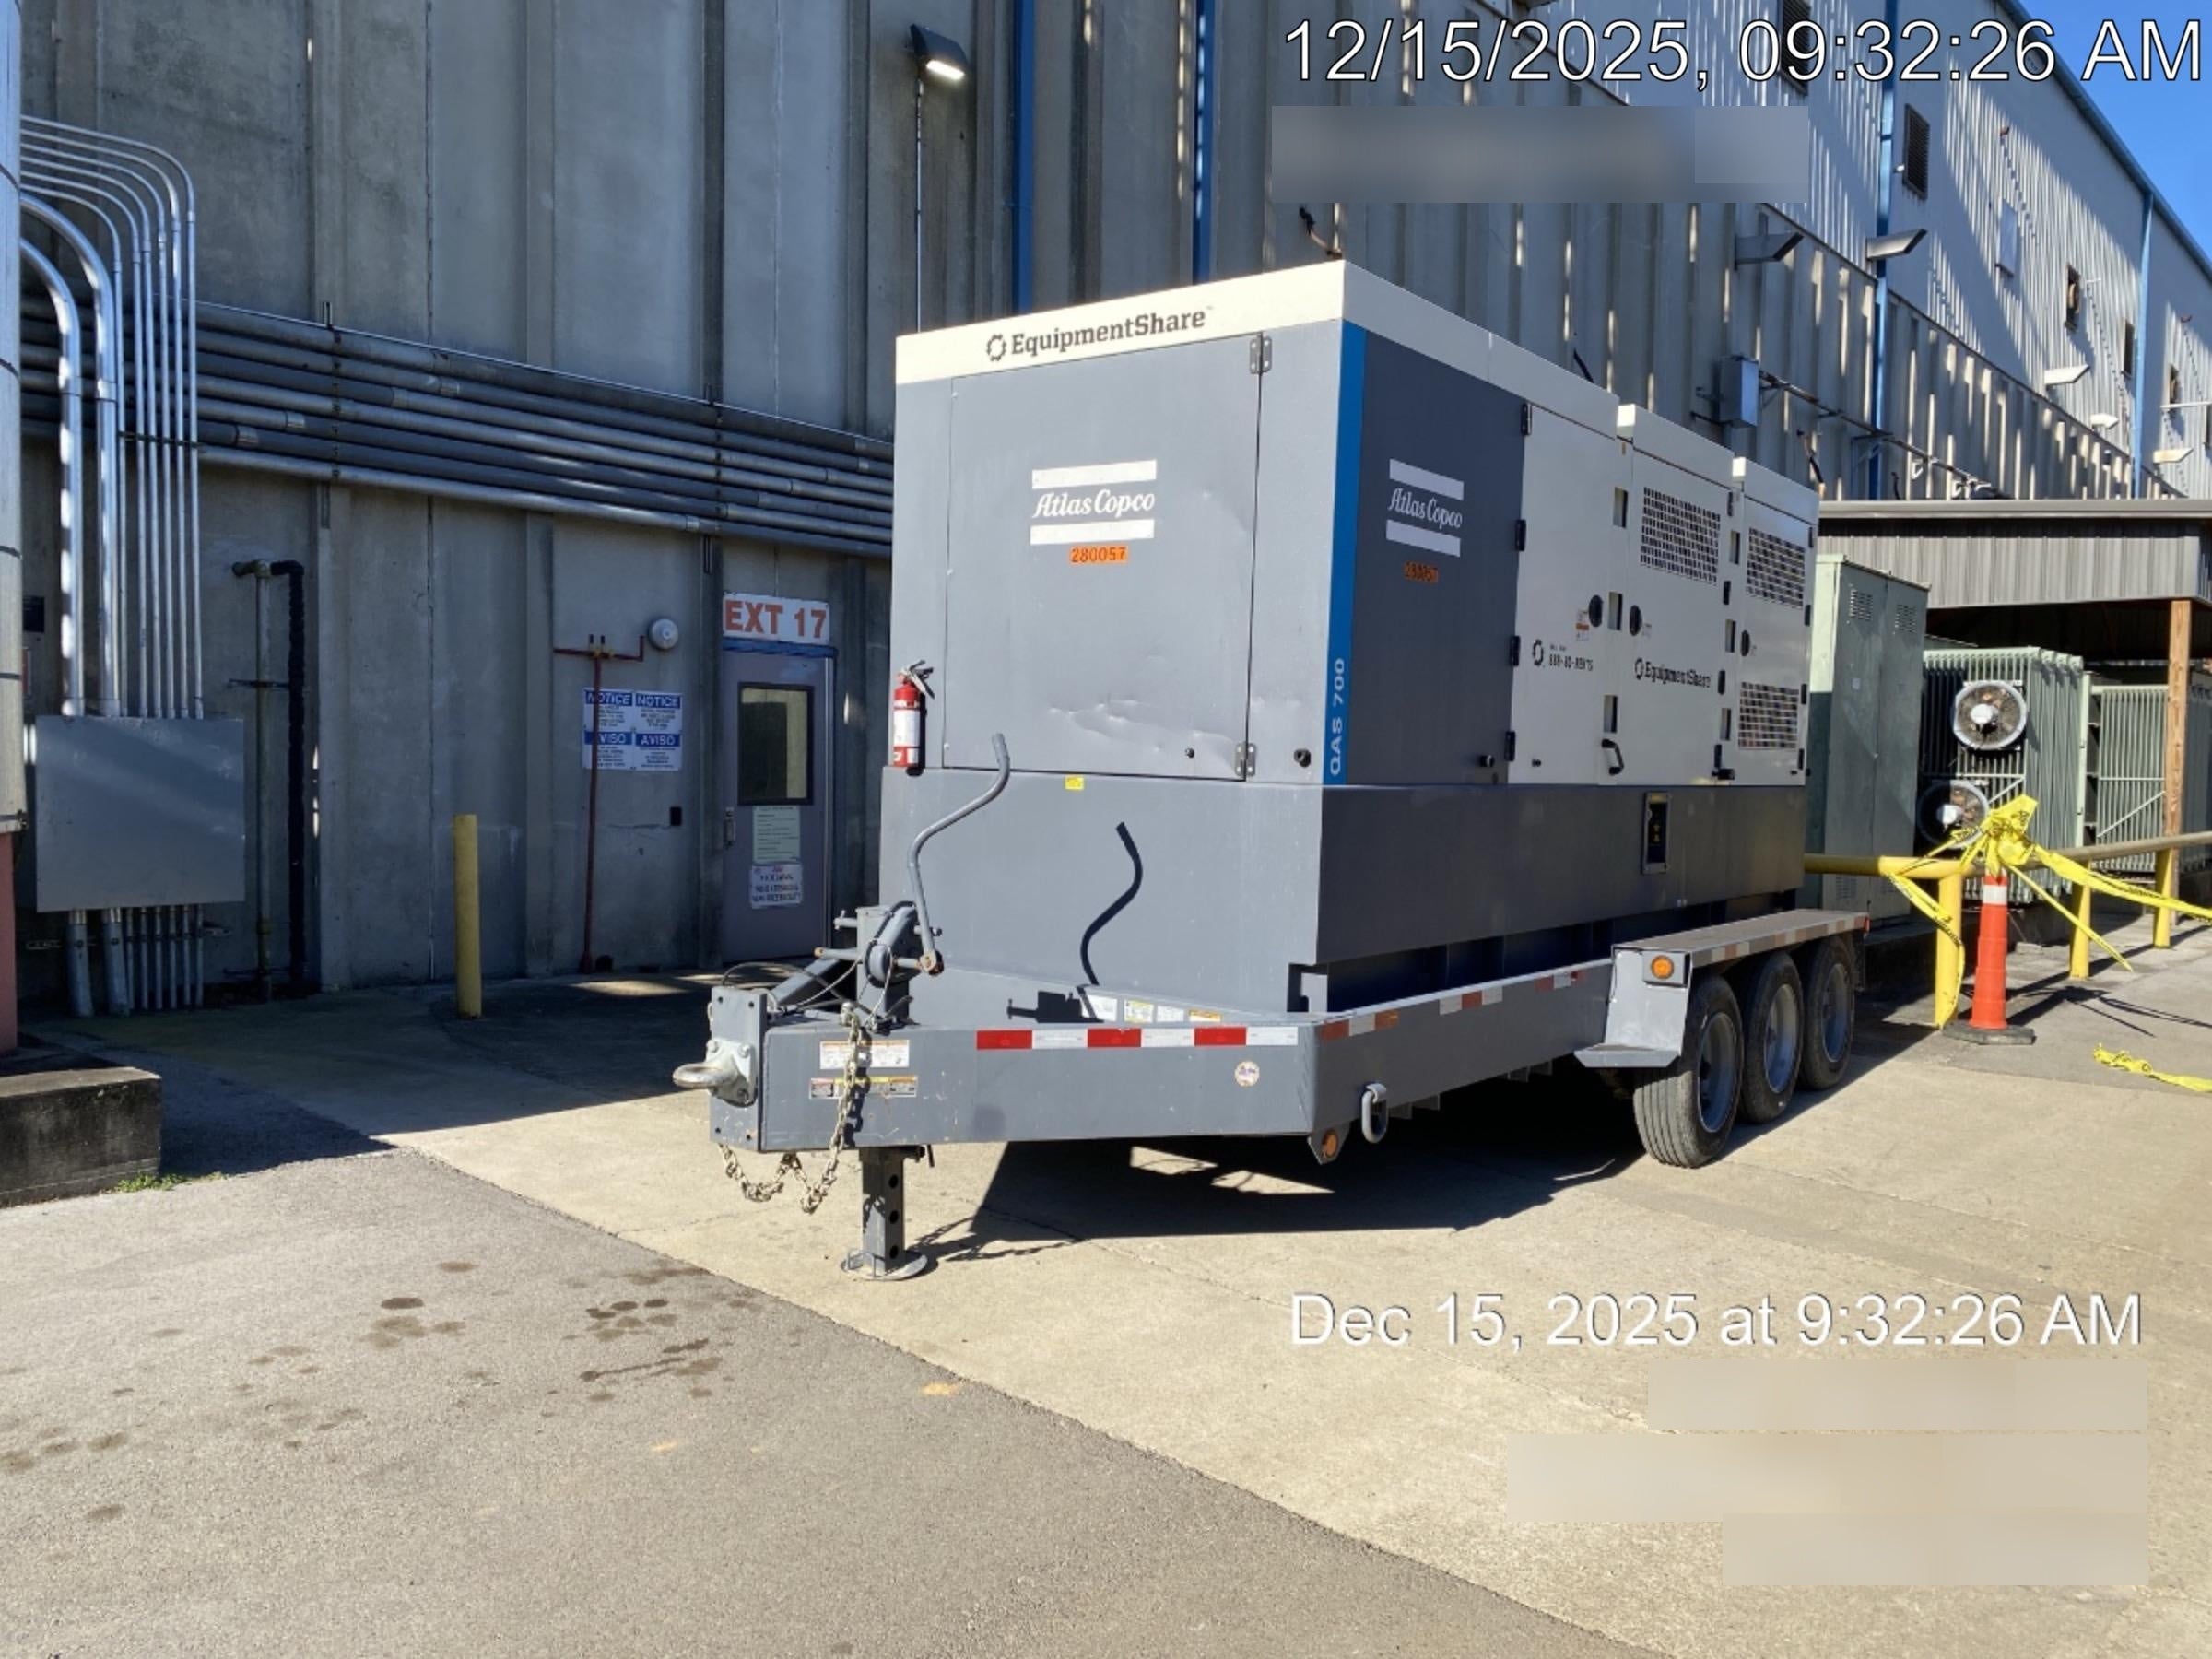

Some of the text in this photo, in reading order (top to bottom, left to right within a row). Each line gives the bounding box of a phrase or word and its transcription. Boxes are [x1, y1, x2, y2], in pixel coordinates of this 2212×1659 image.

[1011, 311, 1206, 358] EquipmentShare
[1031, 488, 1156, 518] Atlas Copco
[1387, 487, 1463, 530] Atlas Copco
[1071, 547, 1126, 563] 280057
[725, 600, 827, 638] EXT 17
[637, 694, 678, 708] NOTICE
[1330, 658, 1345, 776] QAS 700
[594, 733, 627, 745] VISO
[641, 734, 676, 746] AVISO
